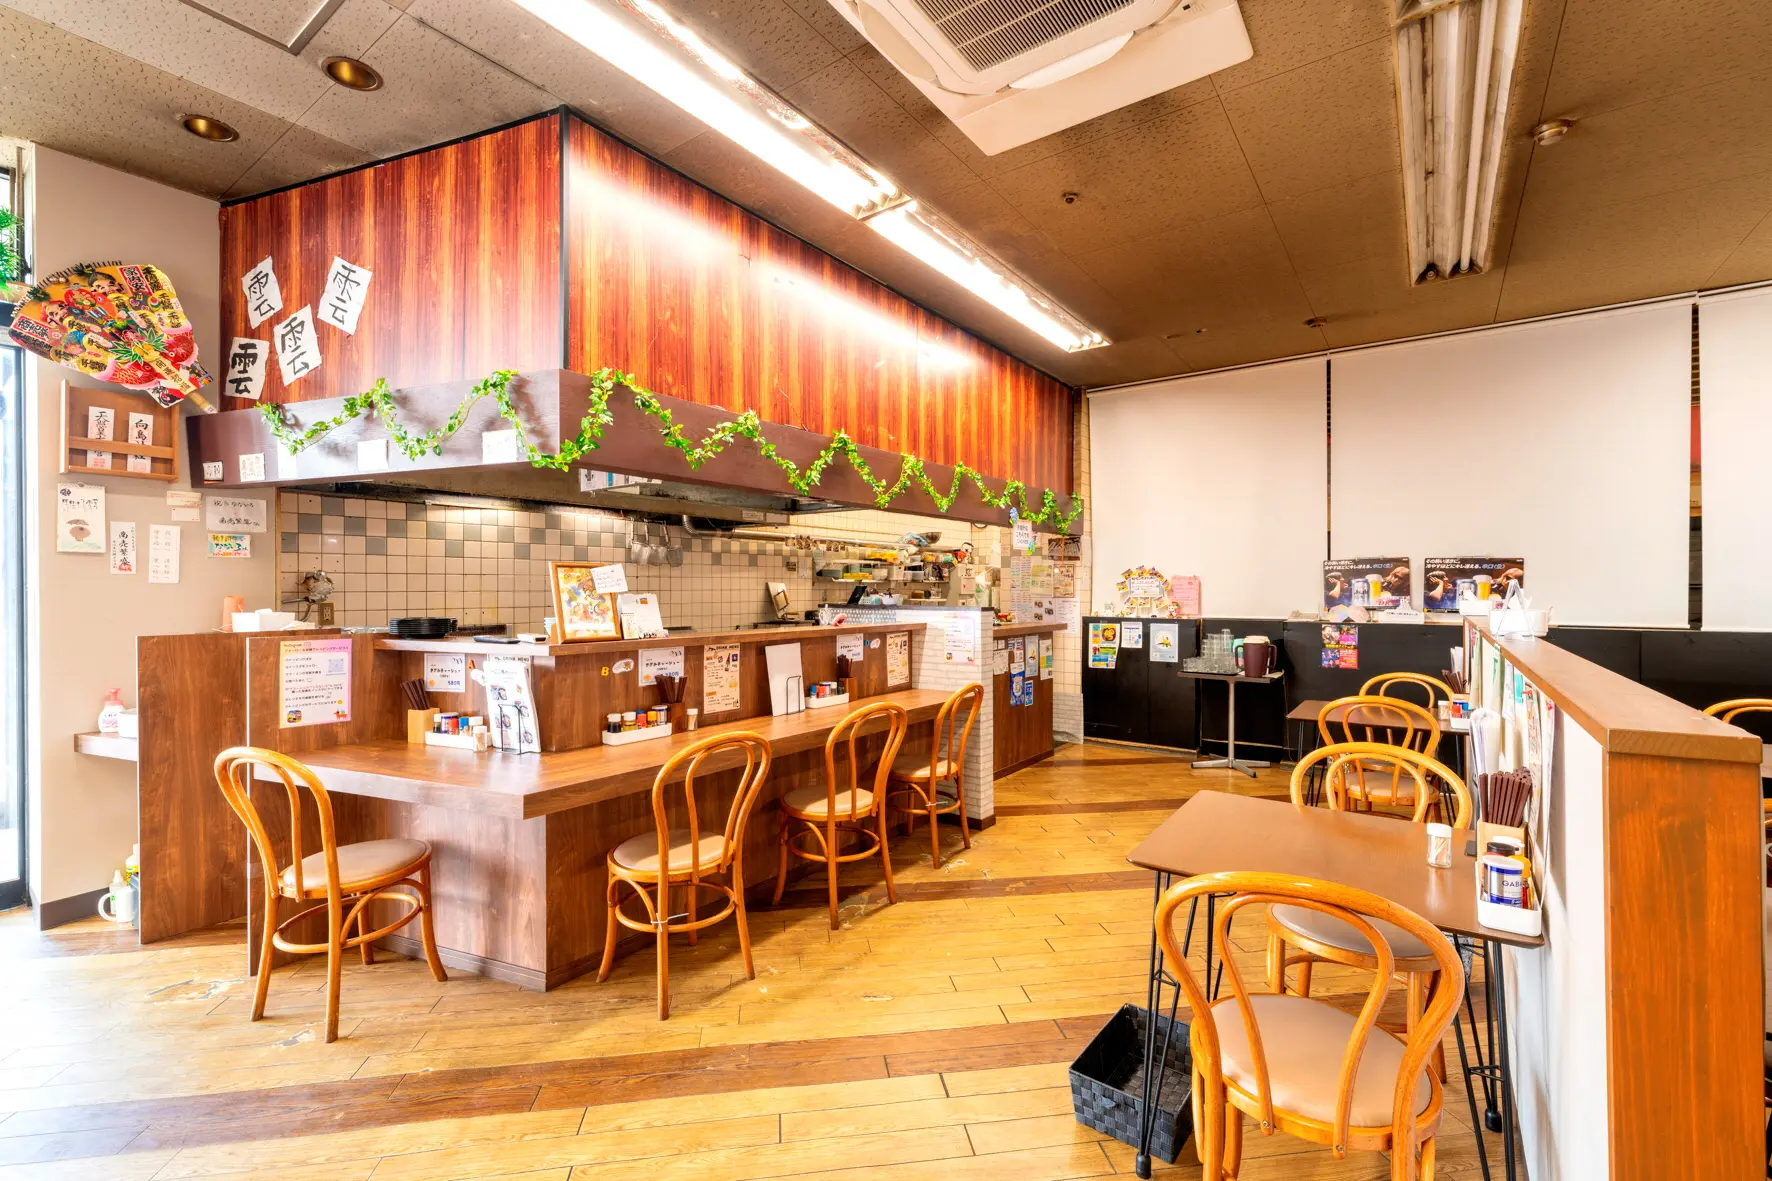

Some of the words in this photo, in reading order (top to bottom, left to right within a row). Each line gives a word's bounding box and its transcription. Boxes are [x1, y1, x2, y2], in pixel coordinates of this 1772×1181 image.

[123, 267, 146, 291] 家内安
[248, 270, 275, 317] 雲
[329, 264, 361, 325] 雲
[18, 318, 50, 339] 商売繁
[281, 316, 310, 375] 雲
[229, 342, 258, 394] 雲
[468, 660, 475, 669] A
[601, 666, 609, 676] B
